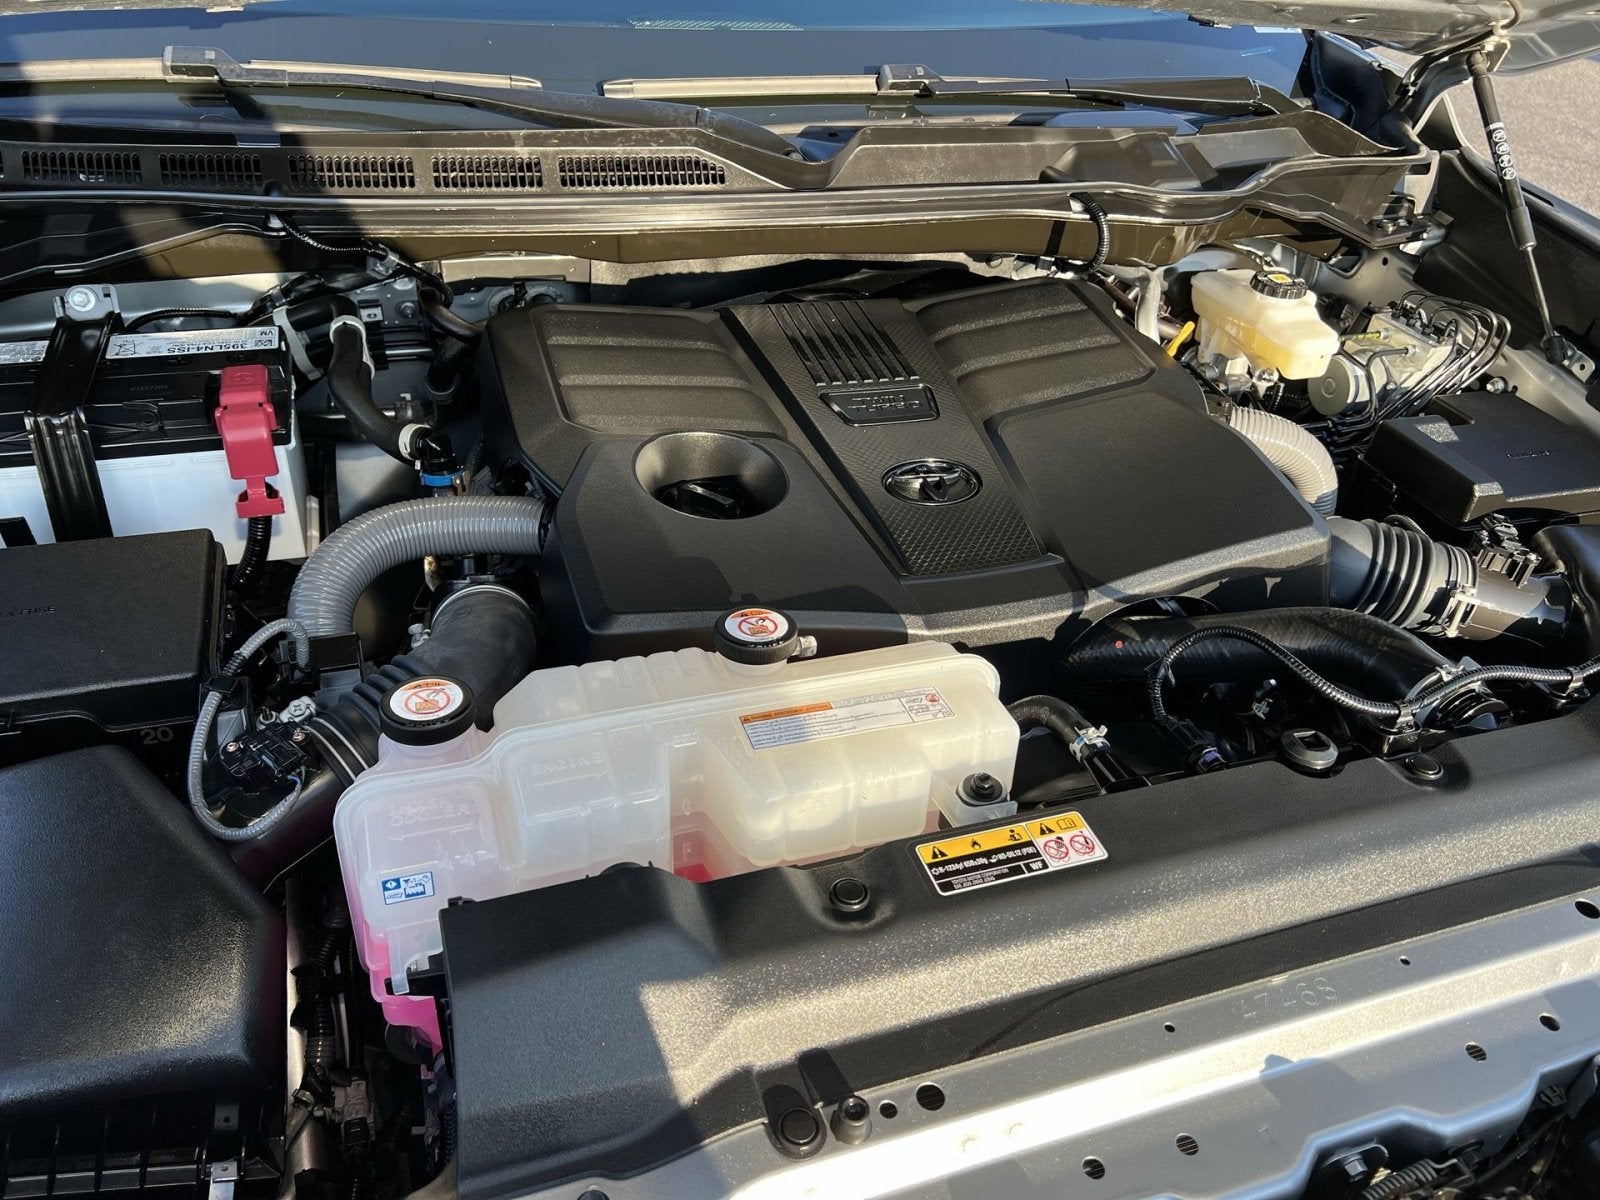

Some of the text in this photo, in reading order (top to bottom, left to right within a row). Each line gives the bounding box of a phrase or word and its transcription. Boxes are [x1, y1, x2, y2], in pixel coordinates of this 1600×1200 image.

[167, 341, 248, 355] 395LN4-ISS
[140, 727, 175, 746] 20
[1029, 861, 1043, 870] WF
